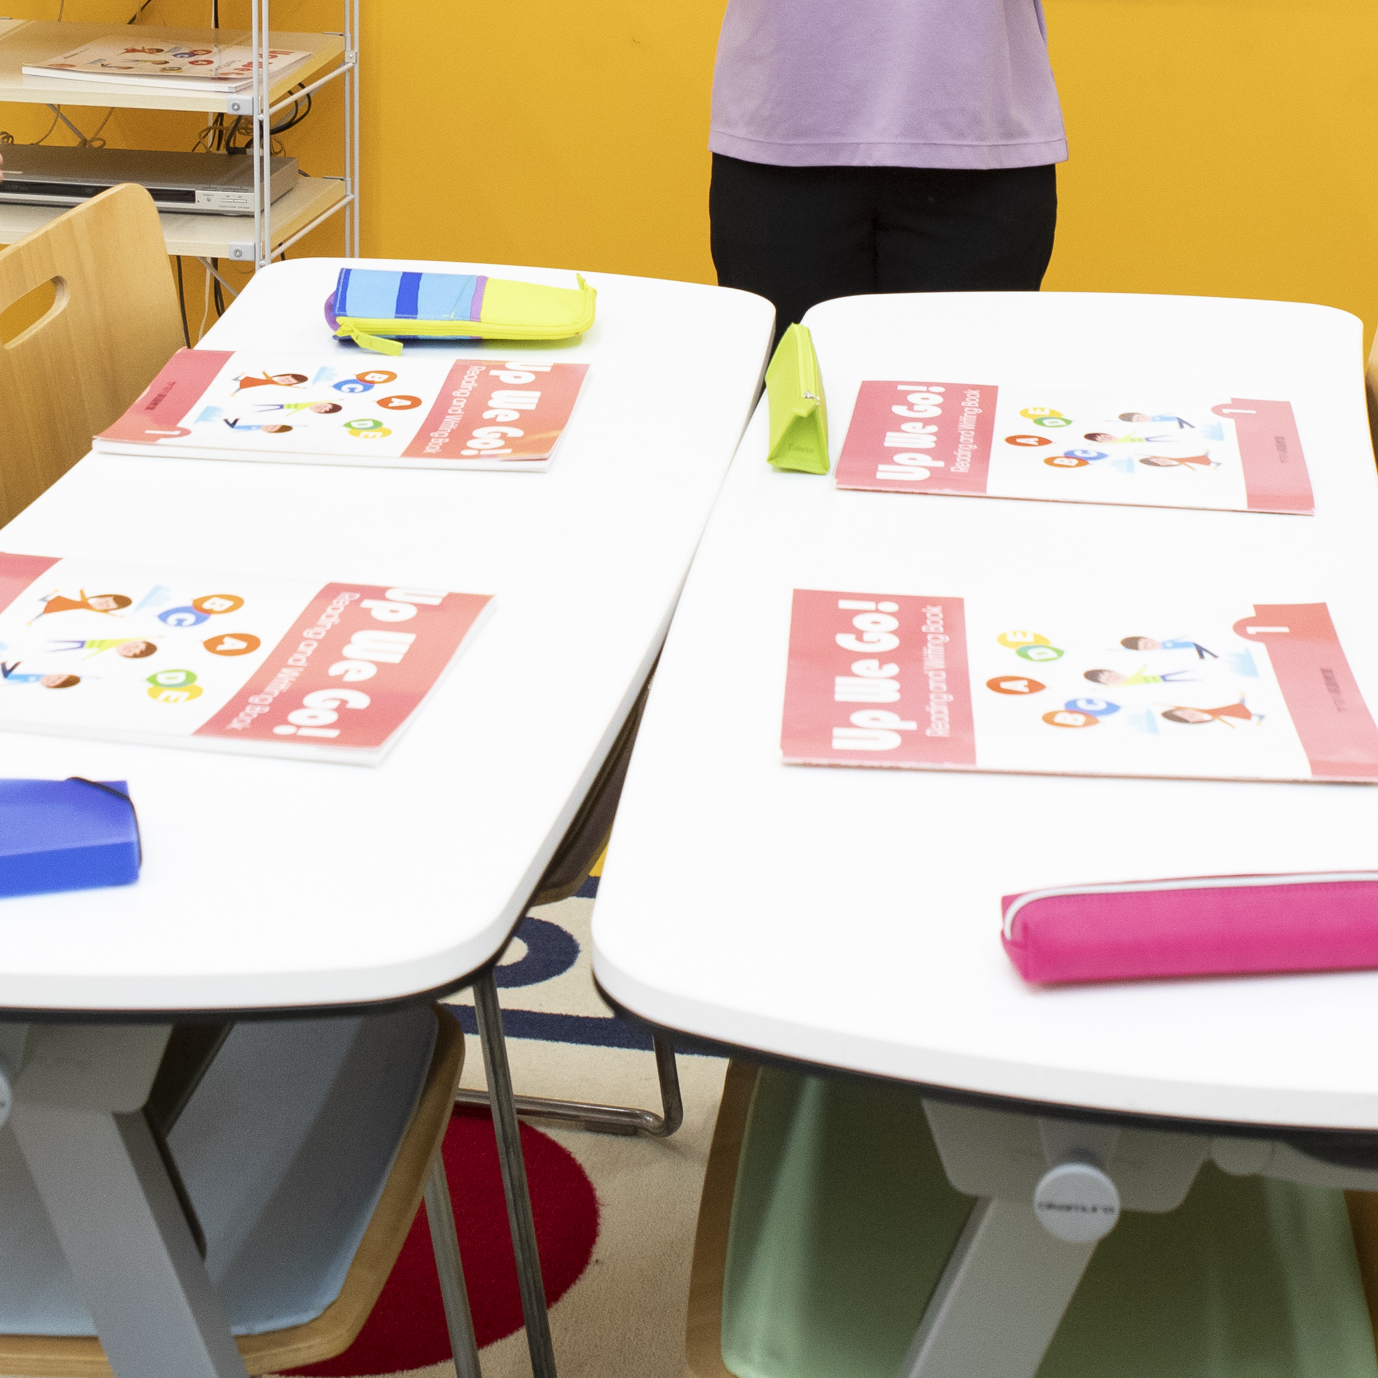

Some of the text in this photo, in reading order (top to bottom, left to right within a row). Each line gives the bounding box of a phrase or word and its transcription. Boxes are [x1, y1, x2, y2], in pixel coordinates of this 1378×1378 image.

[364, 372, 390, 382] B
[340, 383, 364, 393] C
[388, 397, 412, 407] A
[460, 361, 554, 456] Up We Go!
[422, 365, 486, 454] Reading and Writing Book
[1027, 407, 1050, 416] E
[350, 420, 374, 429] D
[1042, 418, 1067, 427] D
[358, 431, 383, 439] E
[876, 384, 946, 481] Up We Go!
[950, 389, 982, 473] Reading and Writing Book
[1016, 437, 1039, 446] A
[1053, 457, 1079, 467] B
[202, 596, 235, 612] B
[166, 612, 197, 627] C
[1006, 630, 1034, 642] E
[1246, 626, 1290, 634] 1
[216, 635, 248, 651] A
[1027, 646, 1059, 661] D
[226, 591, 361, 731] Reading and Writing Book
[272, 587, 449, 738] Up We Go!
[156, 671, 187, 685] D
[832, 599, 918, 751] Up We Go!
[921, 605, 954, 737] Reading and Writing Book
[999, 679, 1030, 693] A
[157, 689, 191, 702] E
[1053, 712, 1086, 727] B
